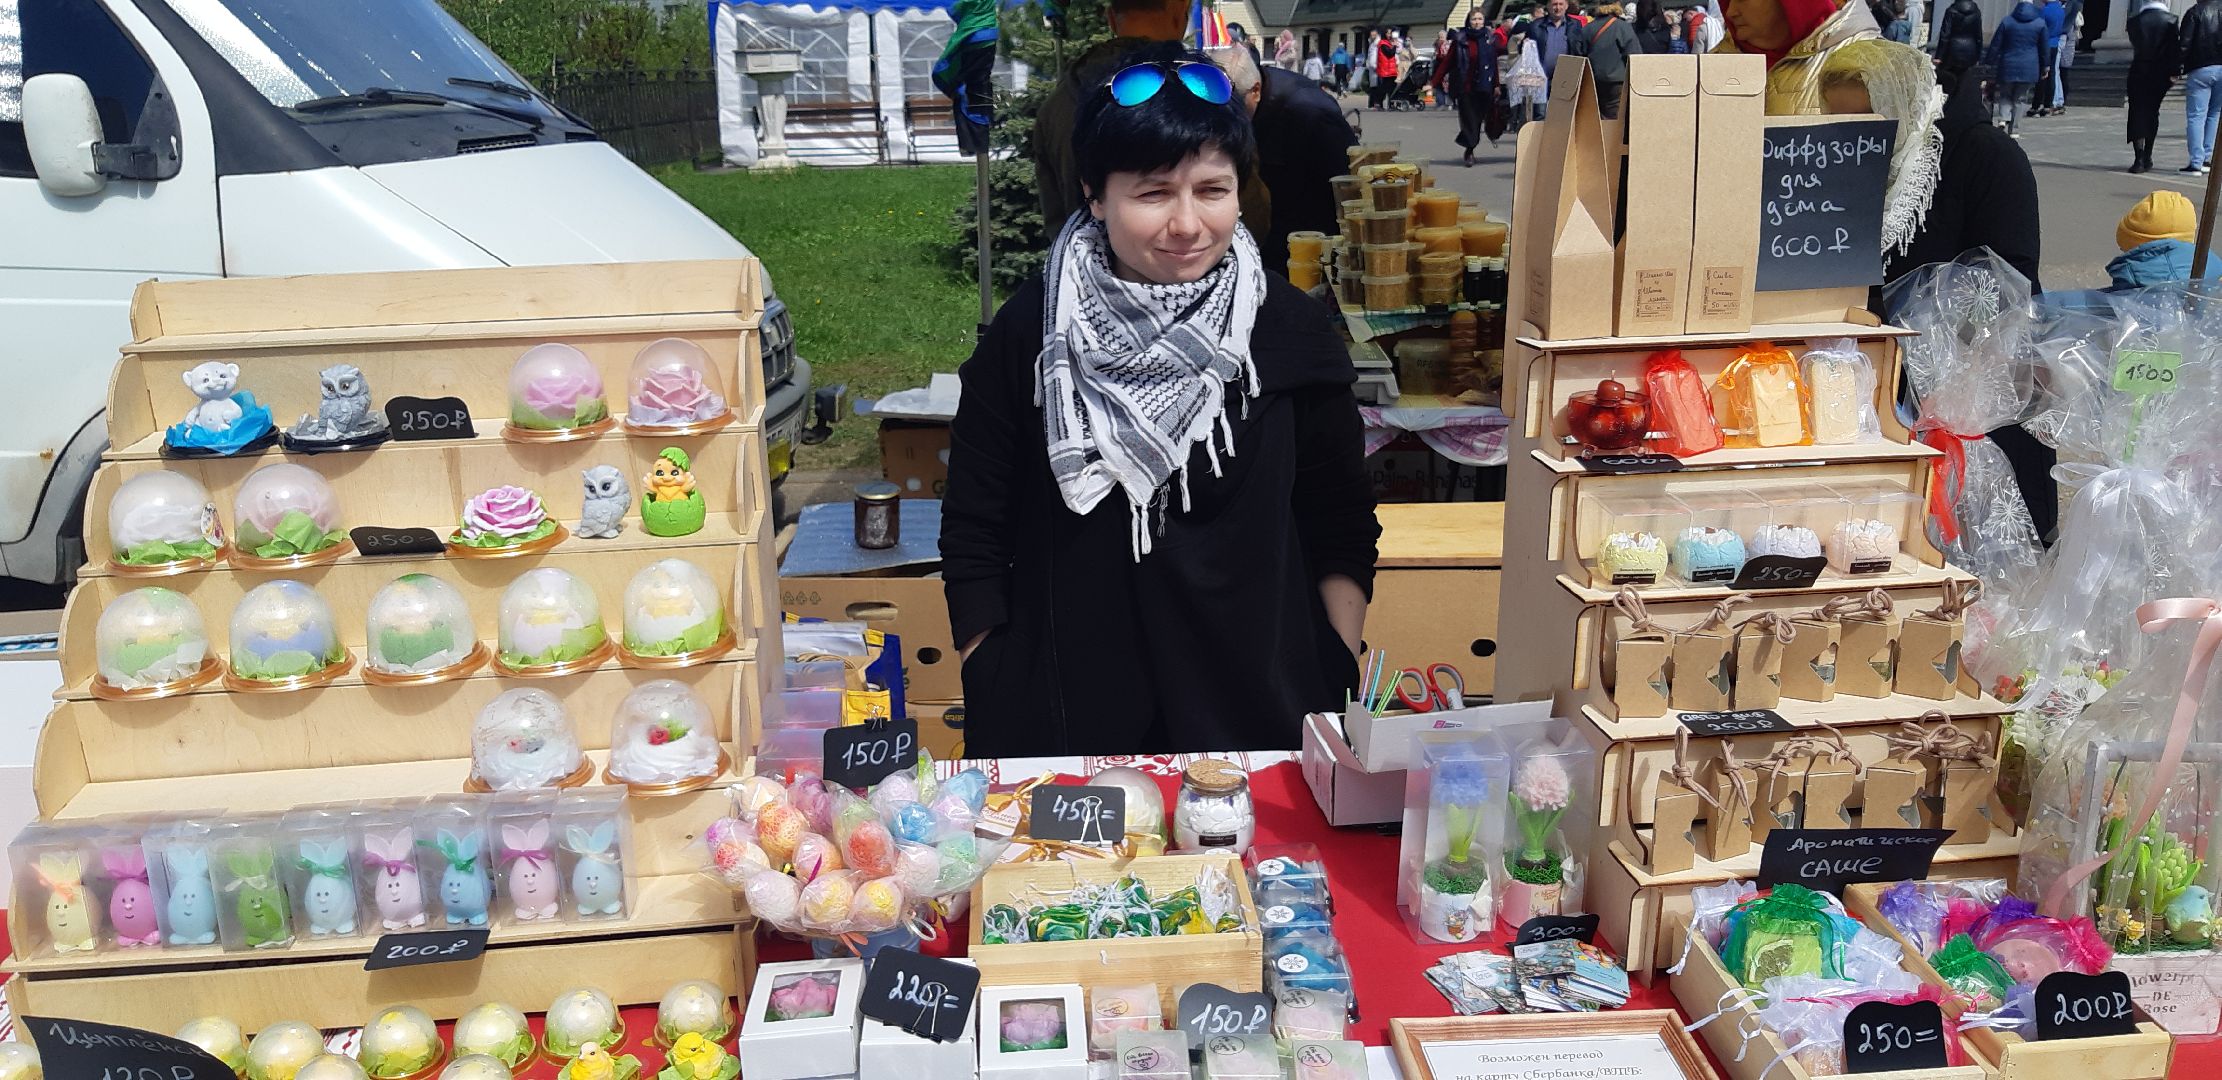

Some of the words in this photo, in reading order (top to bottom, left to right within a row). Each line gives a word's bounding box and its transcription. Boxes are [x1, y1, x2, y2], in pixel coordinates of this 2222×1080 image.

[1779, 173, 1822, 199] для
[1767, 200, 1846, 226] дома
[2152, 991, 2171, 1002] DE
[1858, 1022, 1938, 1054] 250=
[1477, 1053, 1550, 1064] Возможен
[1554, 1050, 1604, 1064] перевод
